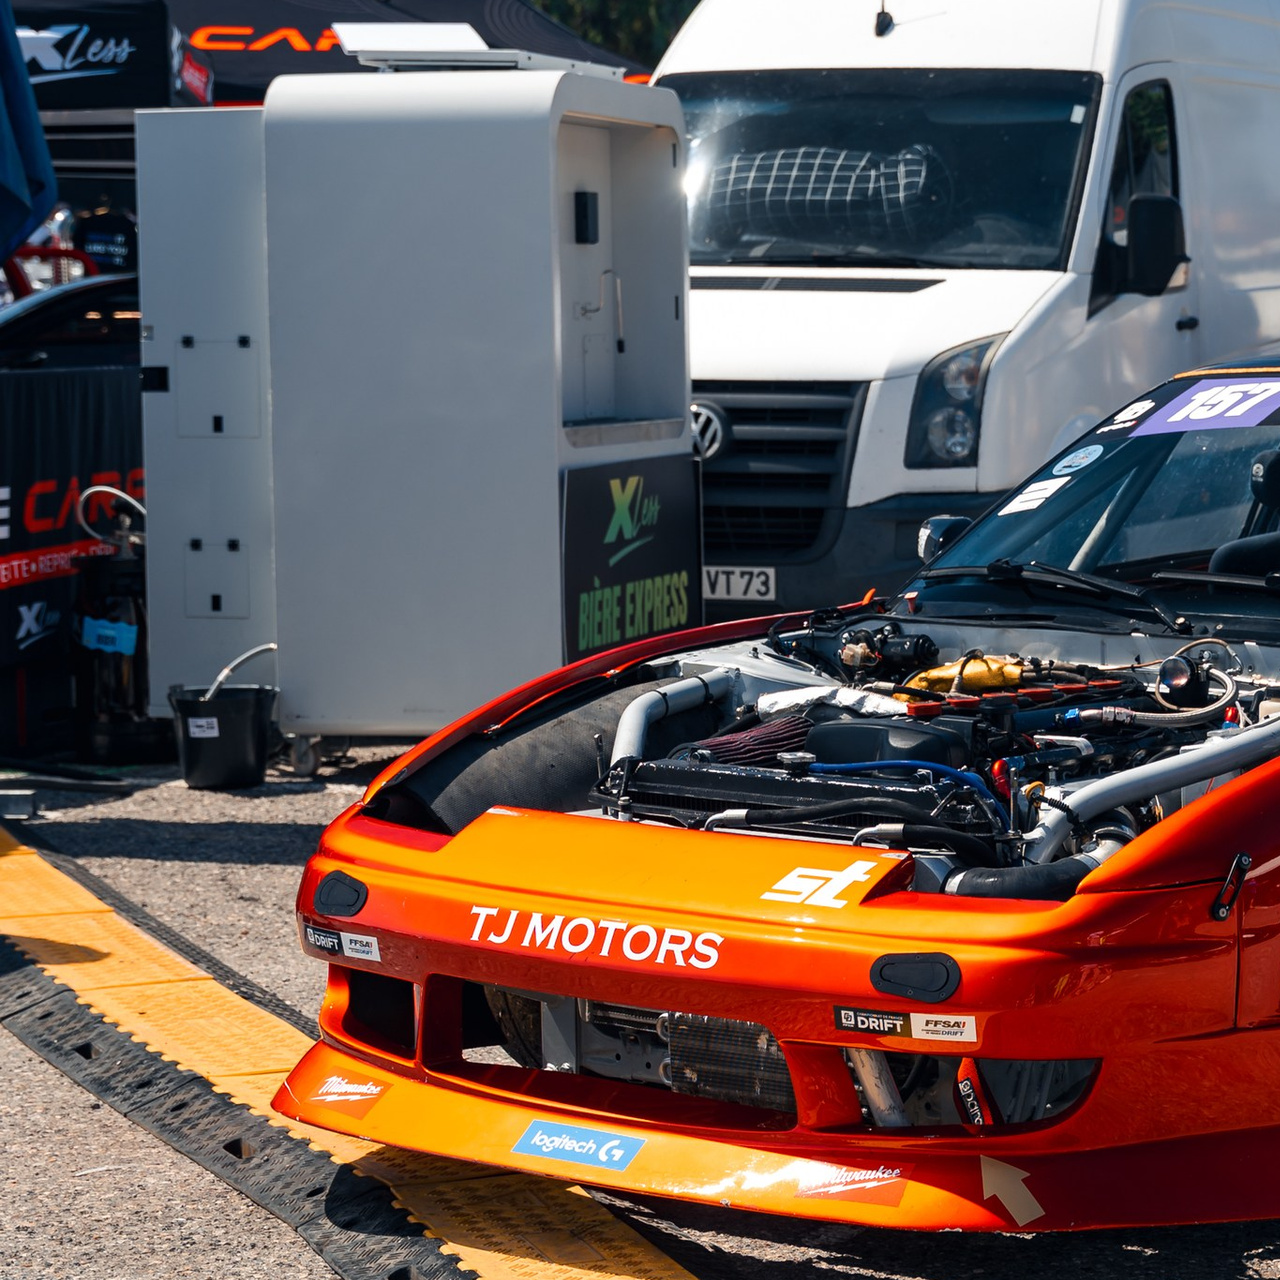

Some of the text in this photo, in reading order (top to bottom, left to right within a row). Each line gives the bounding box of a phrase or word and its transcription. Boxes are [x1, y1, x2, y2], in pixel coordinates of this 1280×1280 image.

[706, 570, 771, 597] VT 73
[578, 571, 688, 651] BIÈRE EXPRESS
[314, 933, 340, 951] DRIFT
[470, 905, 725, 969] TJ MOTORS
[857, 1016, 904, 1033] DRIFT
[925, 1019, 962, 1028] FFSA
[318, 1075, 384, 1095] Milwaukee
[958, 1080, 984, 1126] sparc
[531, 1130, 596, 1156] logitech
